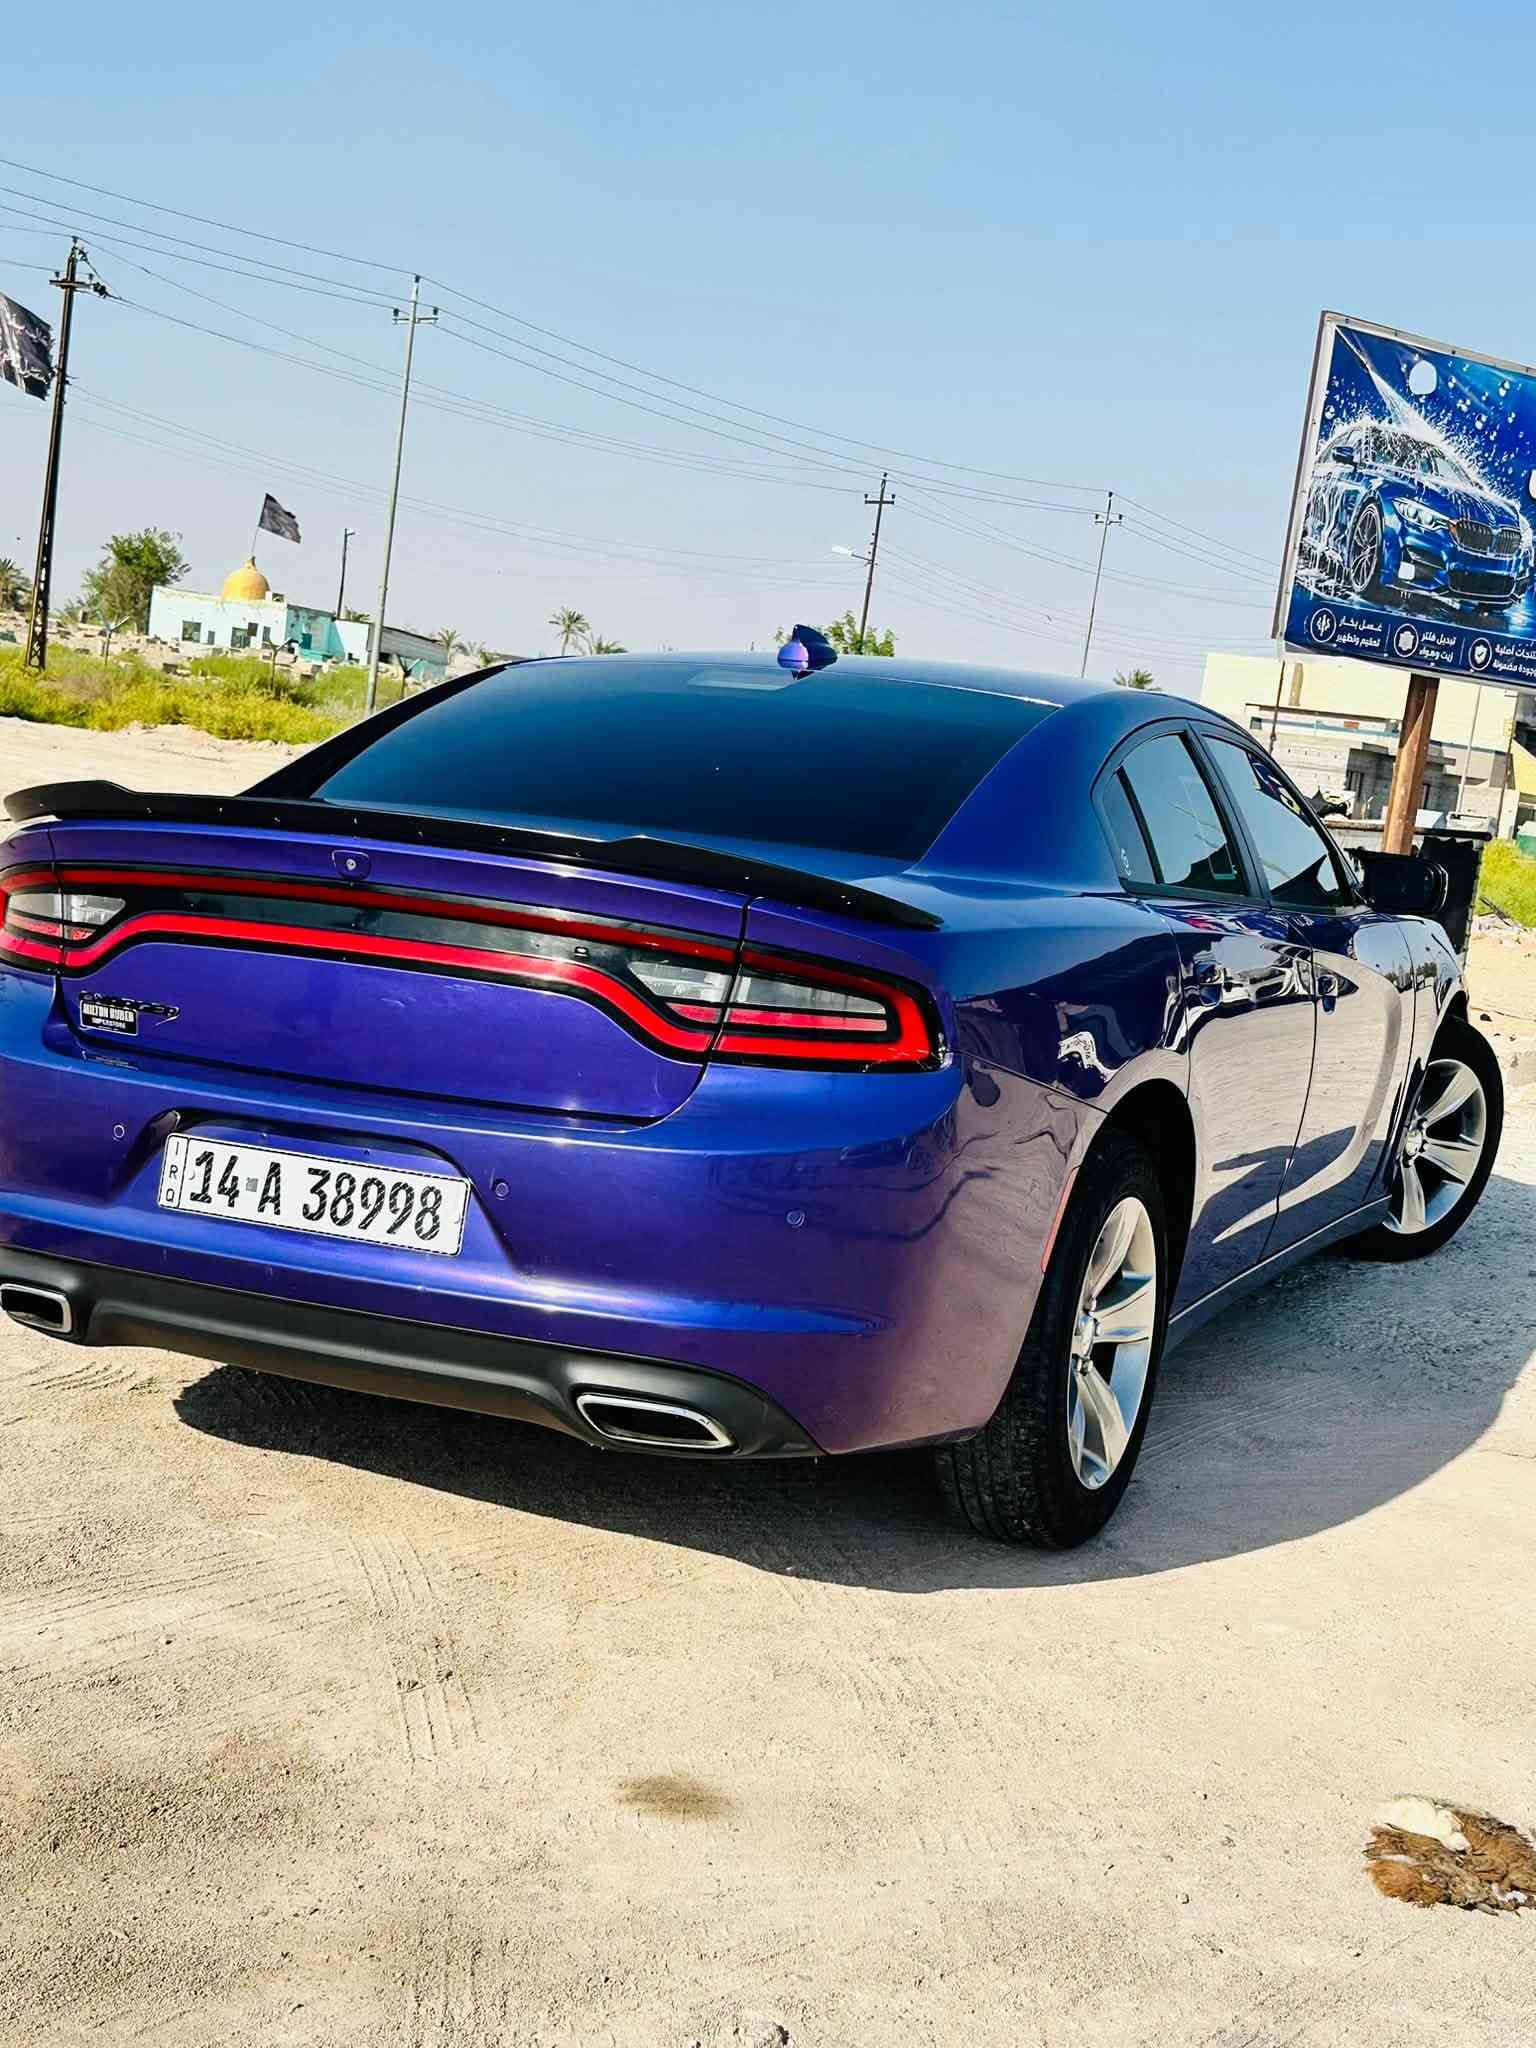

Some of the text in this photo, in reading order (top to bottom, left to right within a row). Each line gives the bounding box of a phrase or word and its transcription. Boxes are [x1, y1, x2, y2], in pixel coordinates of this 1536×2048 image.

[190, 1150, 443, 1241] 14 A 38998
